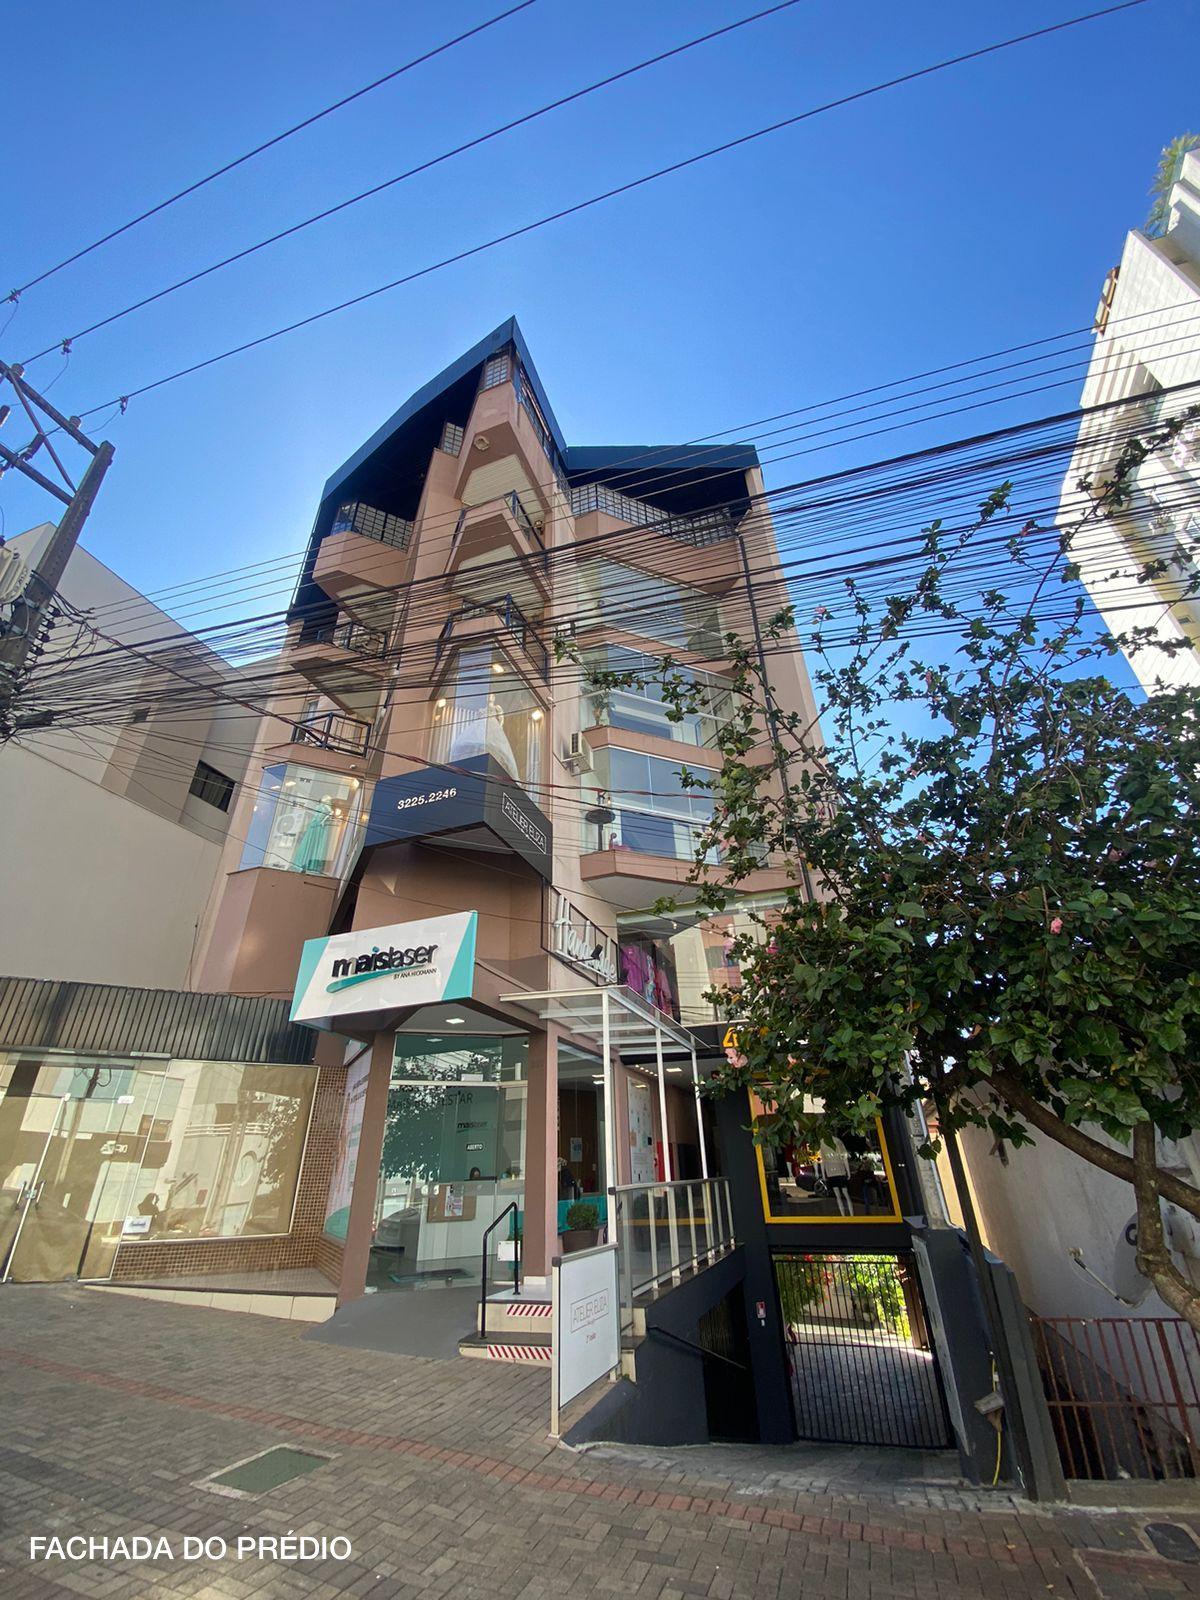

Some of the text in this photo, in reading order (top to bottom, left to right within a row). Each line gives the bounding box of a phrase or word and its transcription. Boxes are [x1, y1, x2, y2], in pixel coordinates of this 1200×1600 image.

[397, 787, 457, 810] 3225.2246
[504, 801, 529, 832] ATELIER
[529, 825, 545, 847] ELIZA
